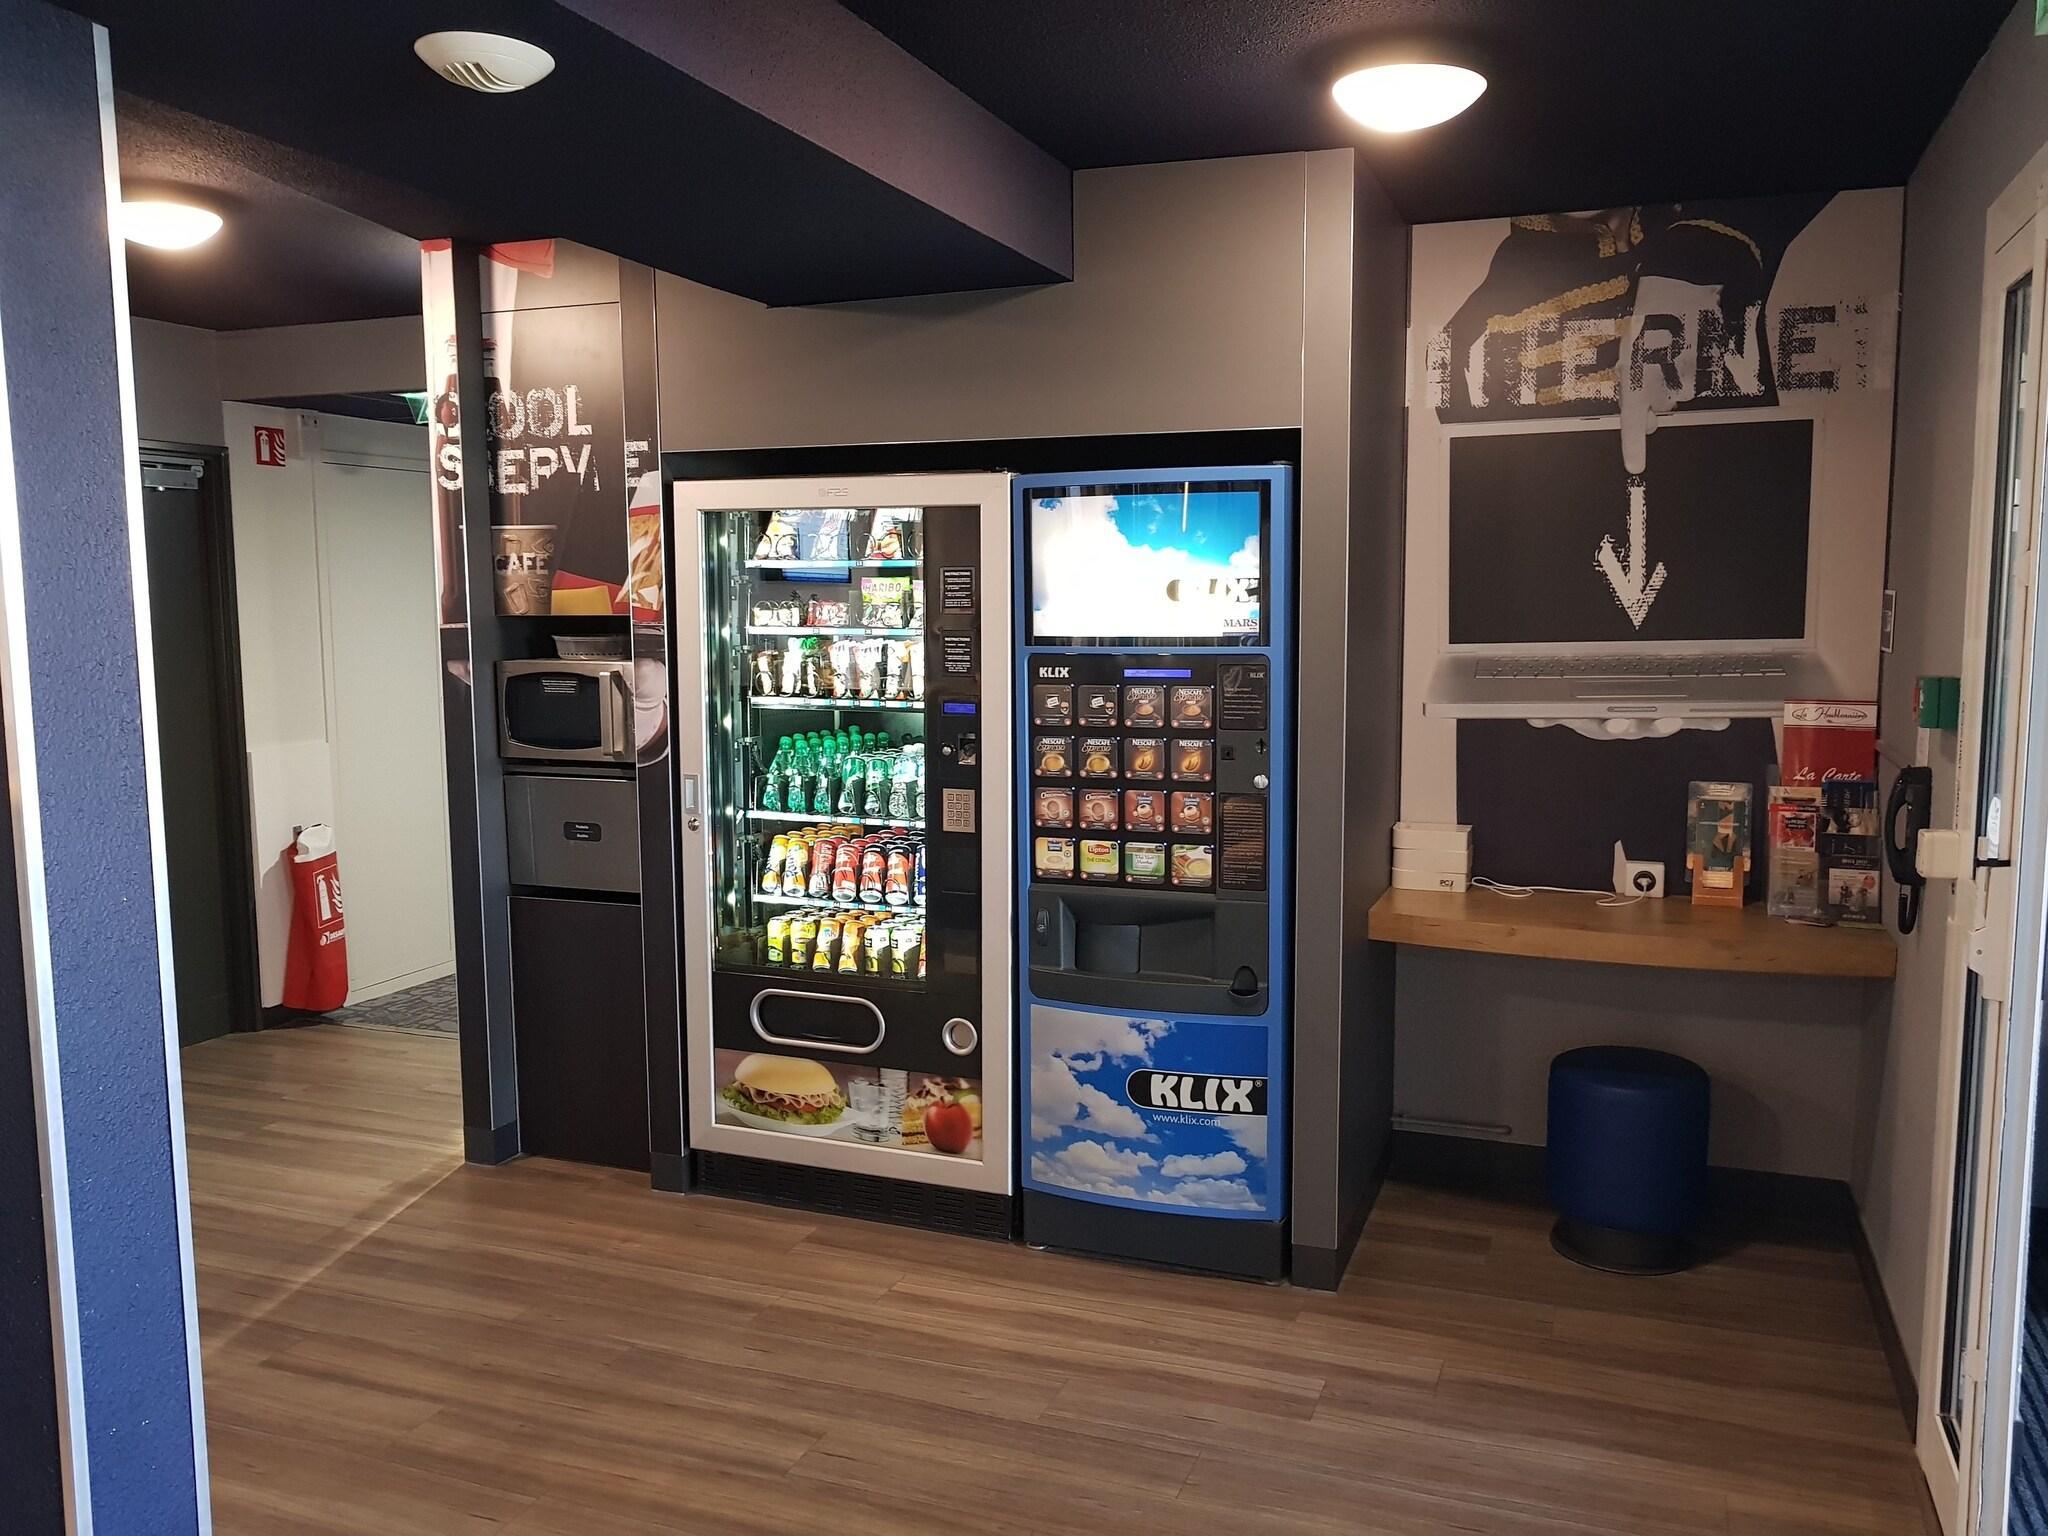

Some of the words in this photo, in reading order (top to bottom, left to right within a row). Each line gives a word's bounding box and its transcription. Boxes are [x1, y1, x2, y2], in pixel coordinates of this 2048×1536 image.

[1223, 618, 1258, 628] MARS
[1038, 666, 1071, 678] KLIX
[1793, 767, 1817, 781] La
[1821, 768, 1862, 782] Carte
[1088, 846, 1110, 855] Lipton
[1150, 1073, 1254, 1113] KLIX
[1153, 1113, 1221, 1127] www.klix.com
